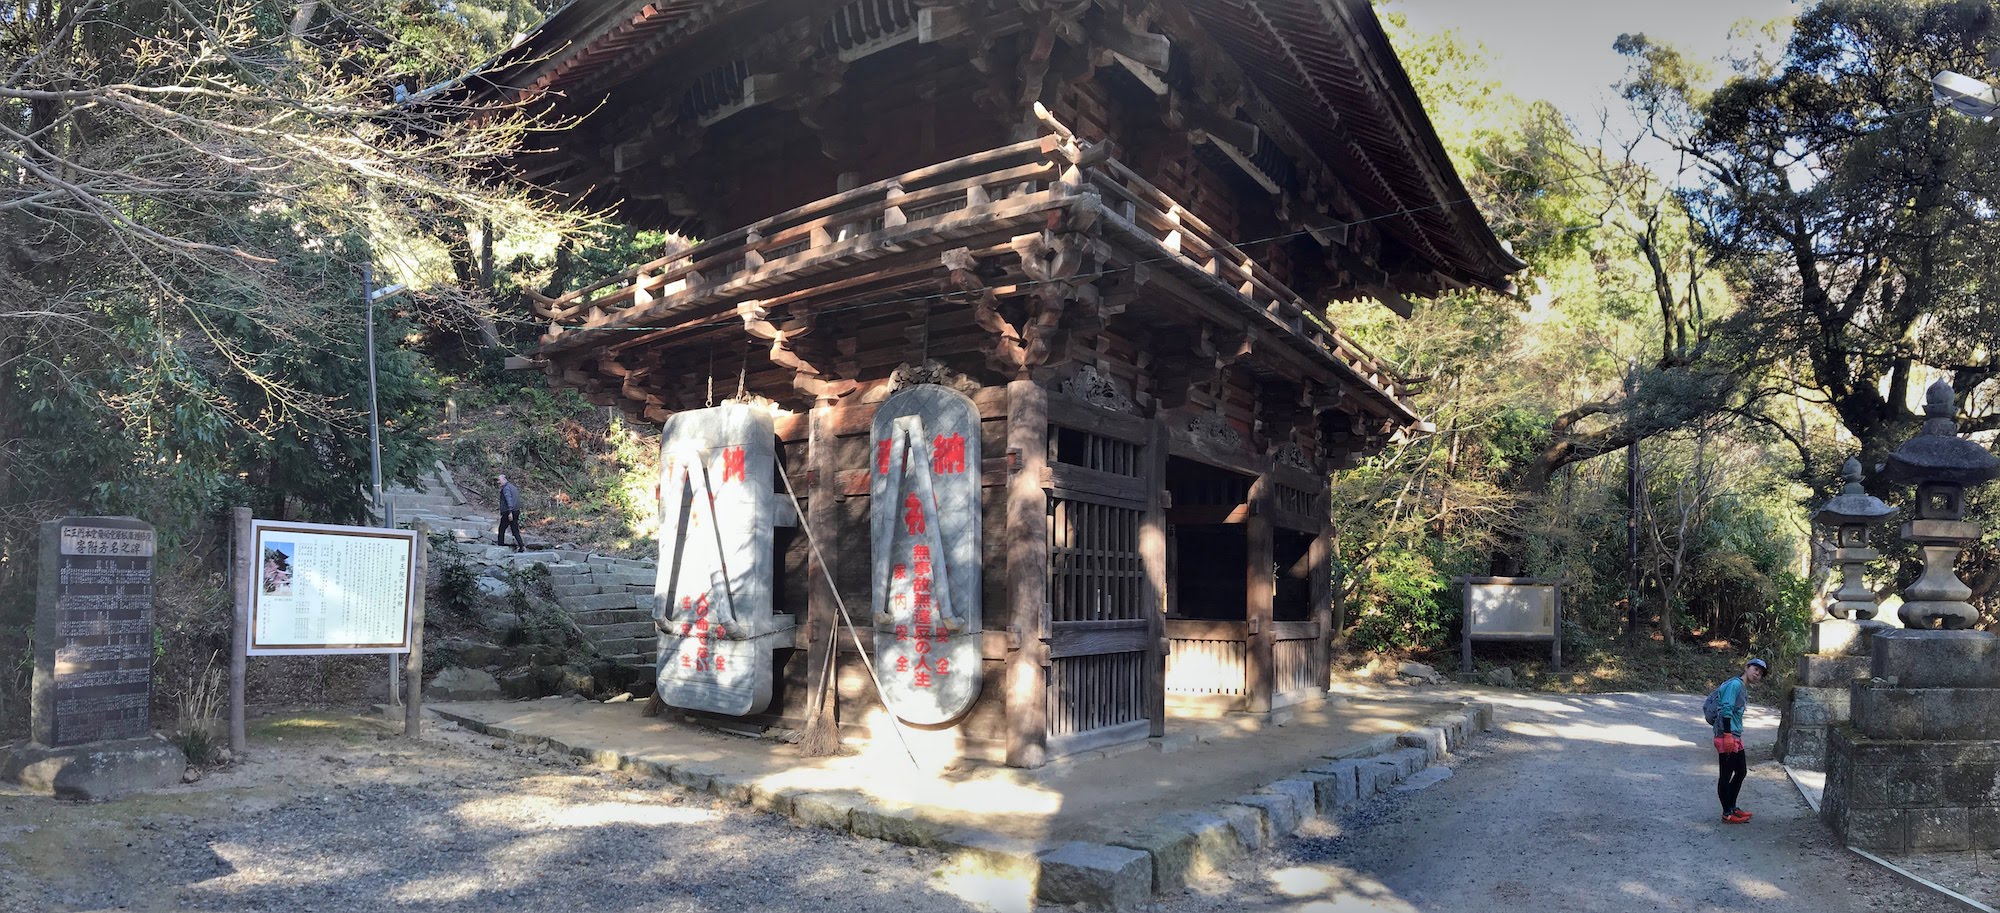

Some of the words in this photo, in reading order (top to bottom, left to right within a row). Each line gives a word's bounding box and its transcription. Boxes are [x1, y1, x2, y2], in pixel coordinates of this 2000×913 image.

[76, 540, 141, 554] 寄附芳名之碑
[894, 564, 908, 672] 家内安全
[912, 544, 932, 688] 無事故無違反の人生
